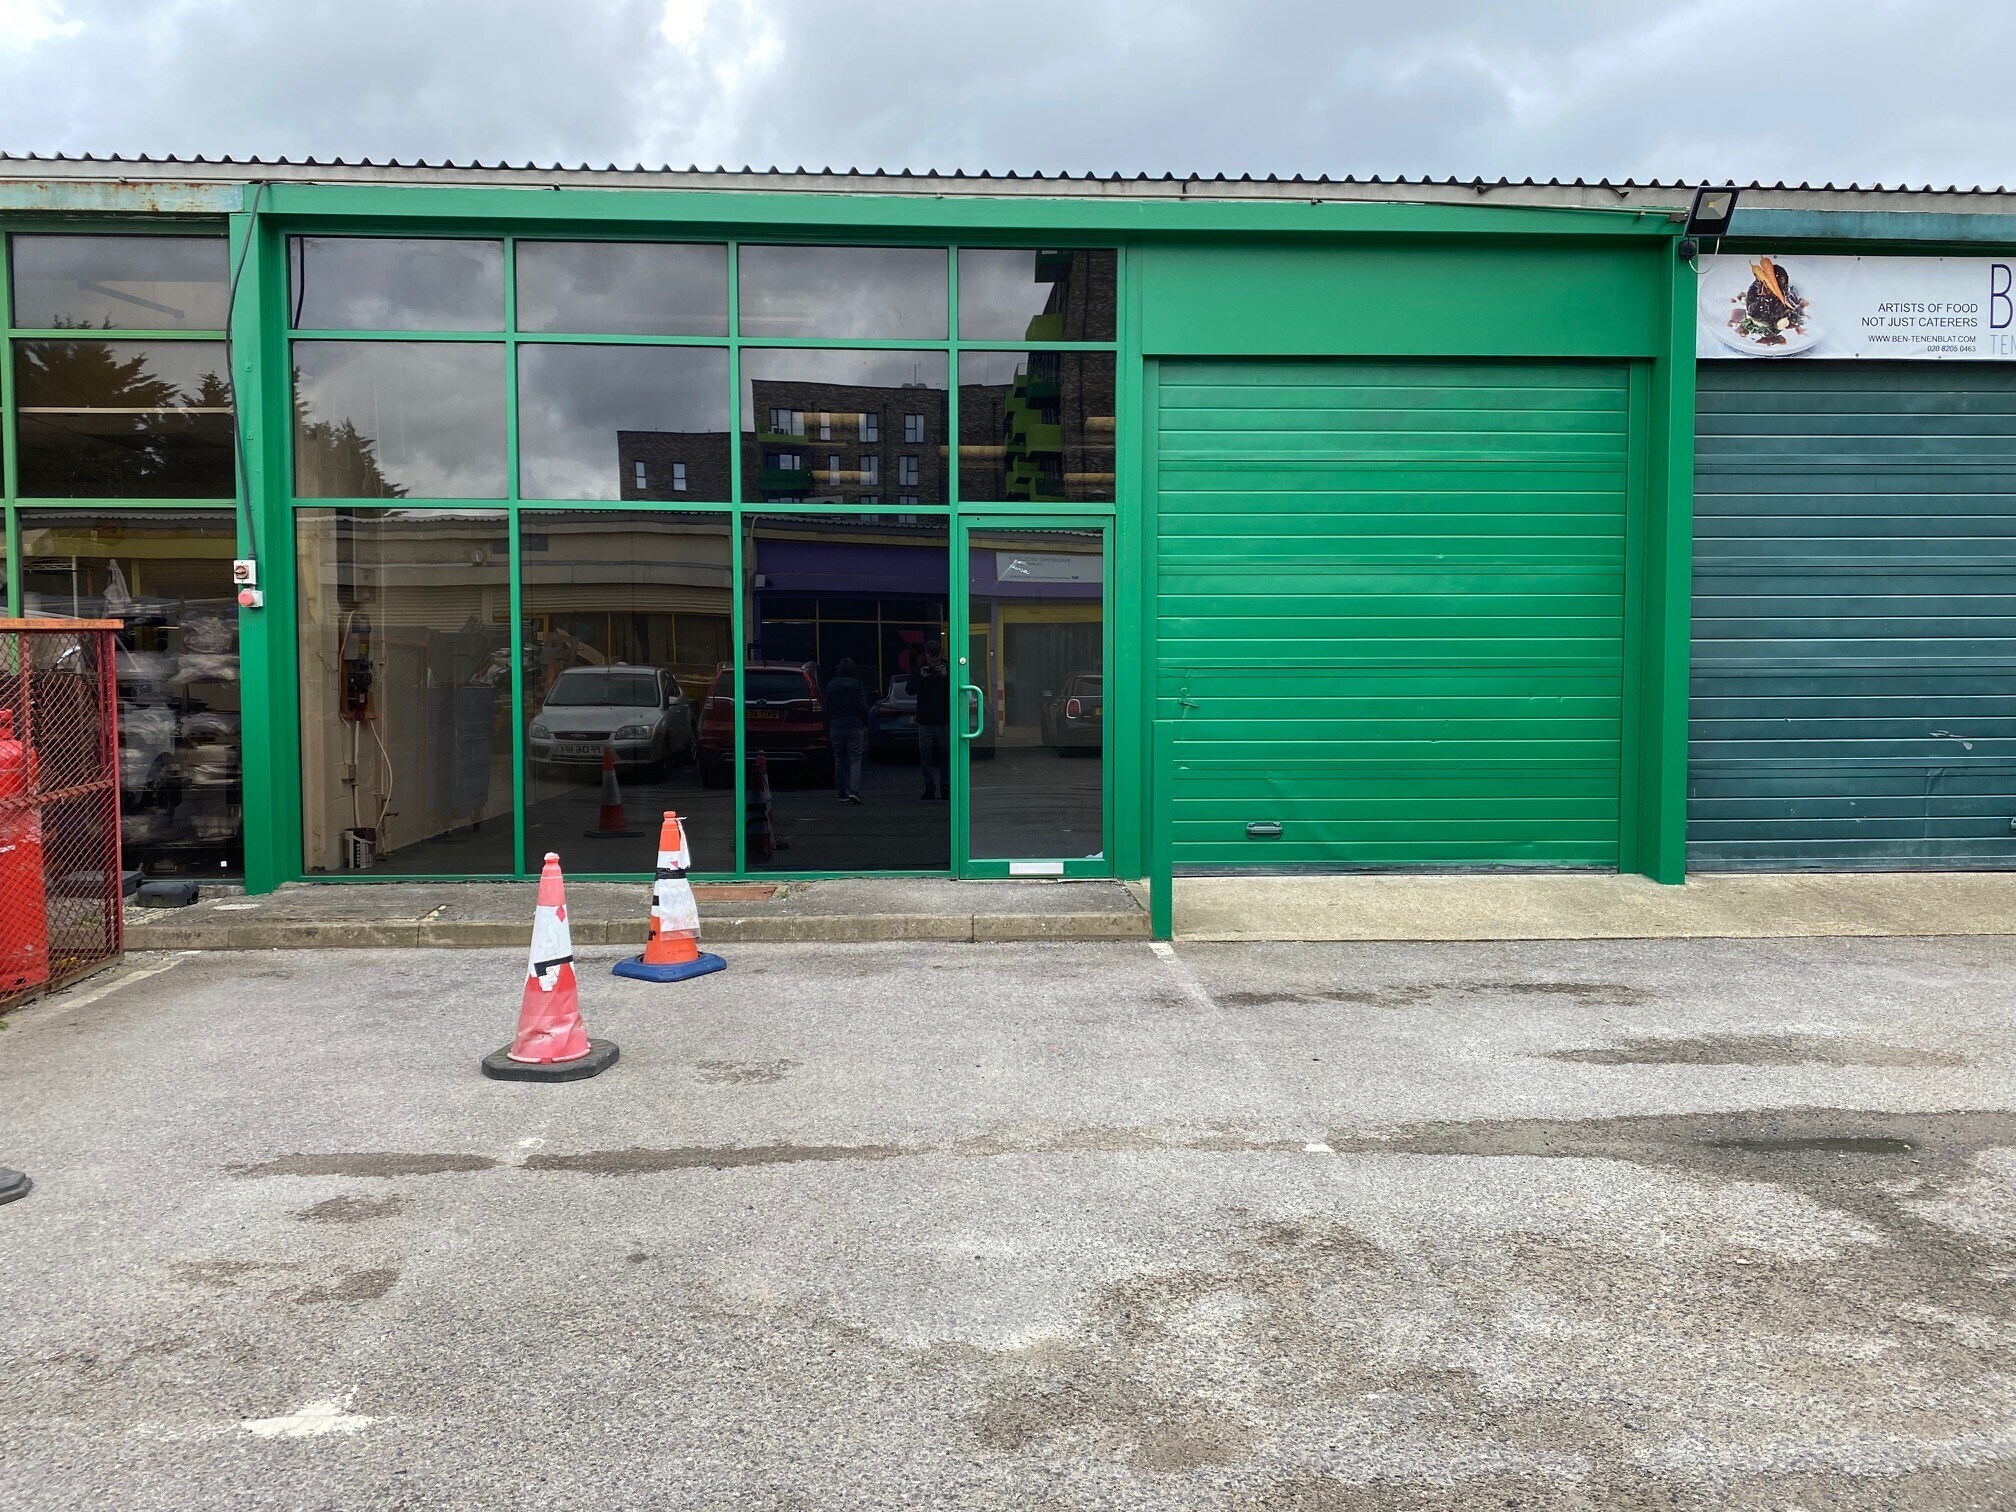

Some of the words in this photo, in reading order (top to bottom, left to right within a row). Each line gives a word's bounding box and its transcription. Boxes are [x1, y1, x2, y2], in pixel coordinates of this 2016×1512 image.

[1878, 303, 1925, 313] ARTISTS
[1928, 303, 1943, 313] OF
[1946, 303, 1978, 313] FOOD
[1861, 317, 1885, 327] NOT
[1888, 317, 1915, 327] JUST
[1918, 317, 1978, 327] CATERERS
